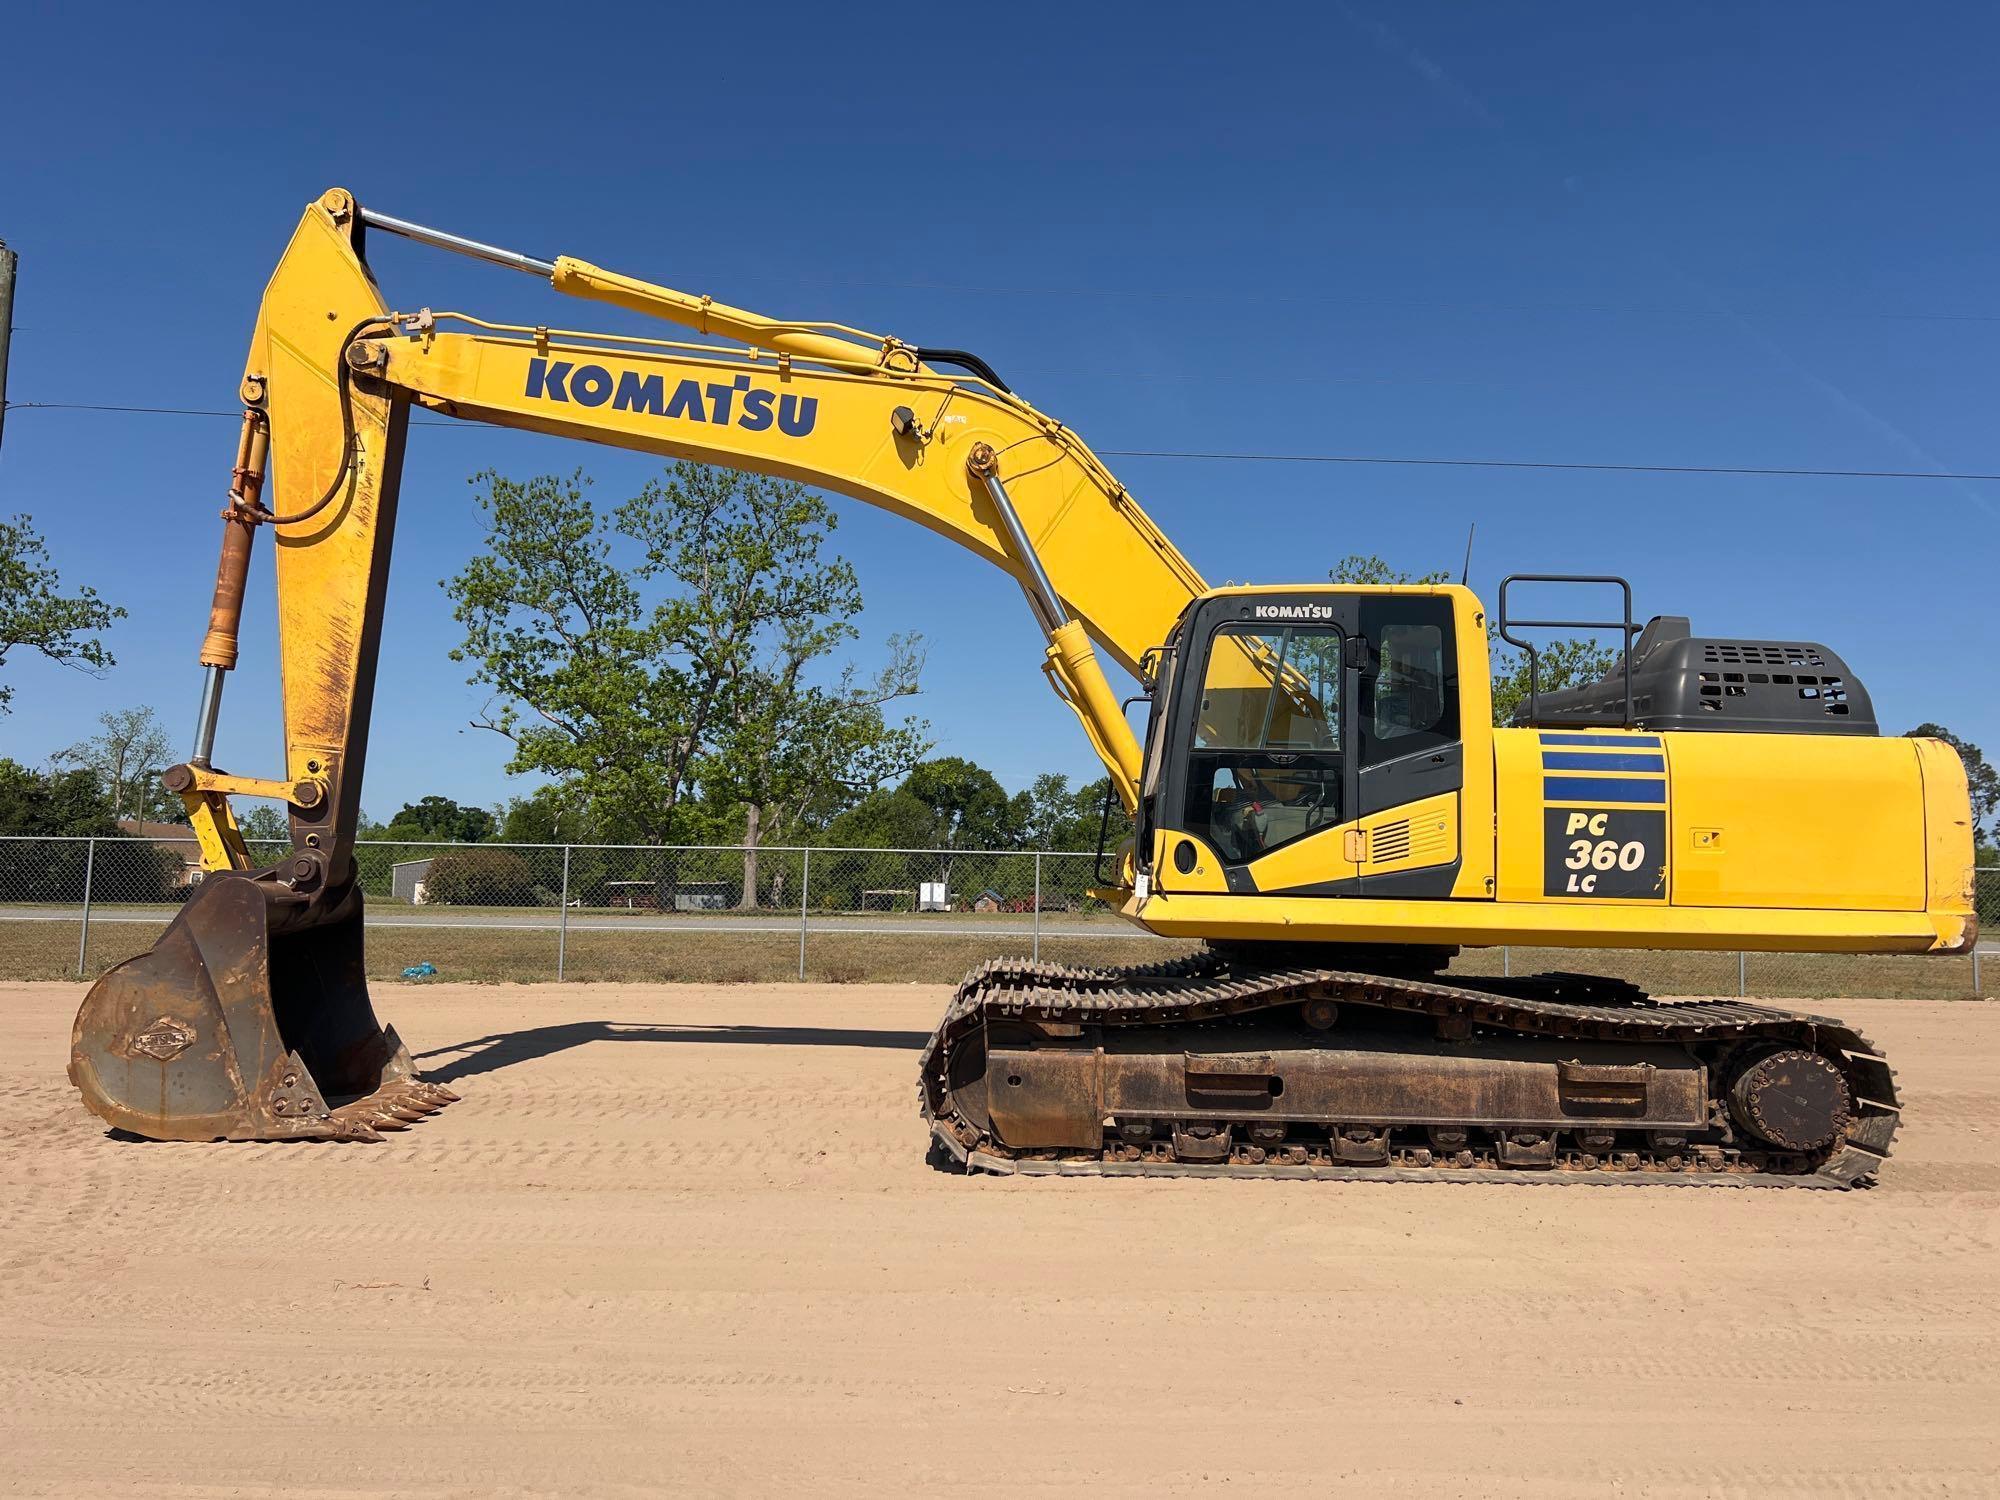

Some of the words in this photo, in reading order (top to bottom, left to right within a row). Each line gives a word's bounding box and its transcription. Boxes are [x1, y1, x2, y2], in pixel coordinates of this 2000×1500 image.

[525, 357, 818, 437] KOMATSU
[1255, 603, 1333, 619] KOMATSU
[1565, 812, 1609, 837] PC
[1565, 839, 1645, 872] 360
[1566, 873, 1597, 893] LC
